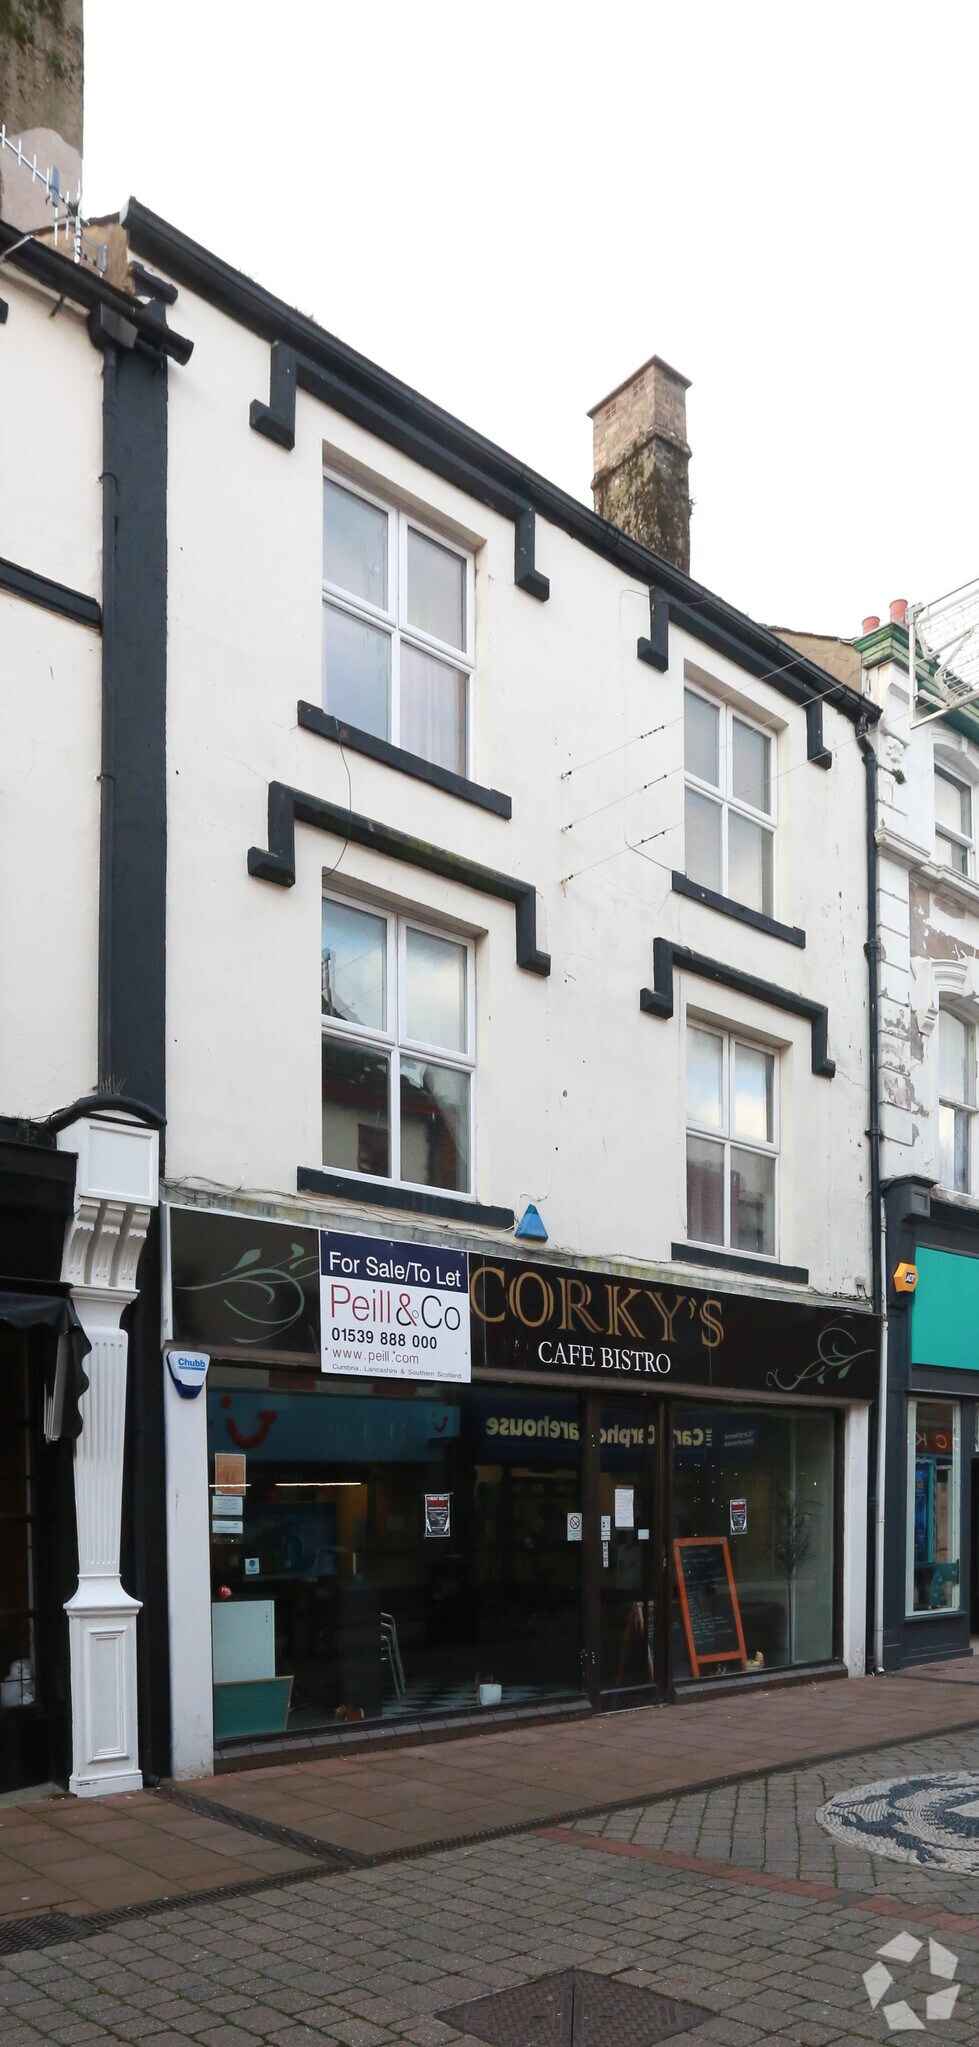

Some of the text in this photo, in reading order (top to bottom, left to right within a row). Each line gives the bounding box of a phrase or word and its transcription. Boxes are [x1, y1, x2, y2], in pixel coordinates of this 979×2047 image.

[329, 1251, 461, 1287] For Sale/To Let
[470, 1266, 726, 1348] CORKY'S
[331, 1327, 438, 1350] 01539 888 000
[178, 1357, 206, 1368] Chubb
[332, 1349, 419, 1364] www.peill.com
[537, 1341, 671, 1375] CAFE BISTRO
[332, 1363, 361, 1372] Cumbria,
[364, 1366, 397, 1375] Lancashire
[408, 1369, 435, 1377] Southern
[437, 1371, 462, 1379] Scotland
